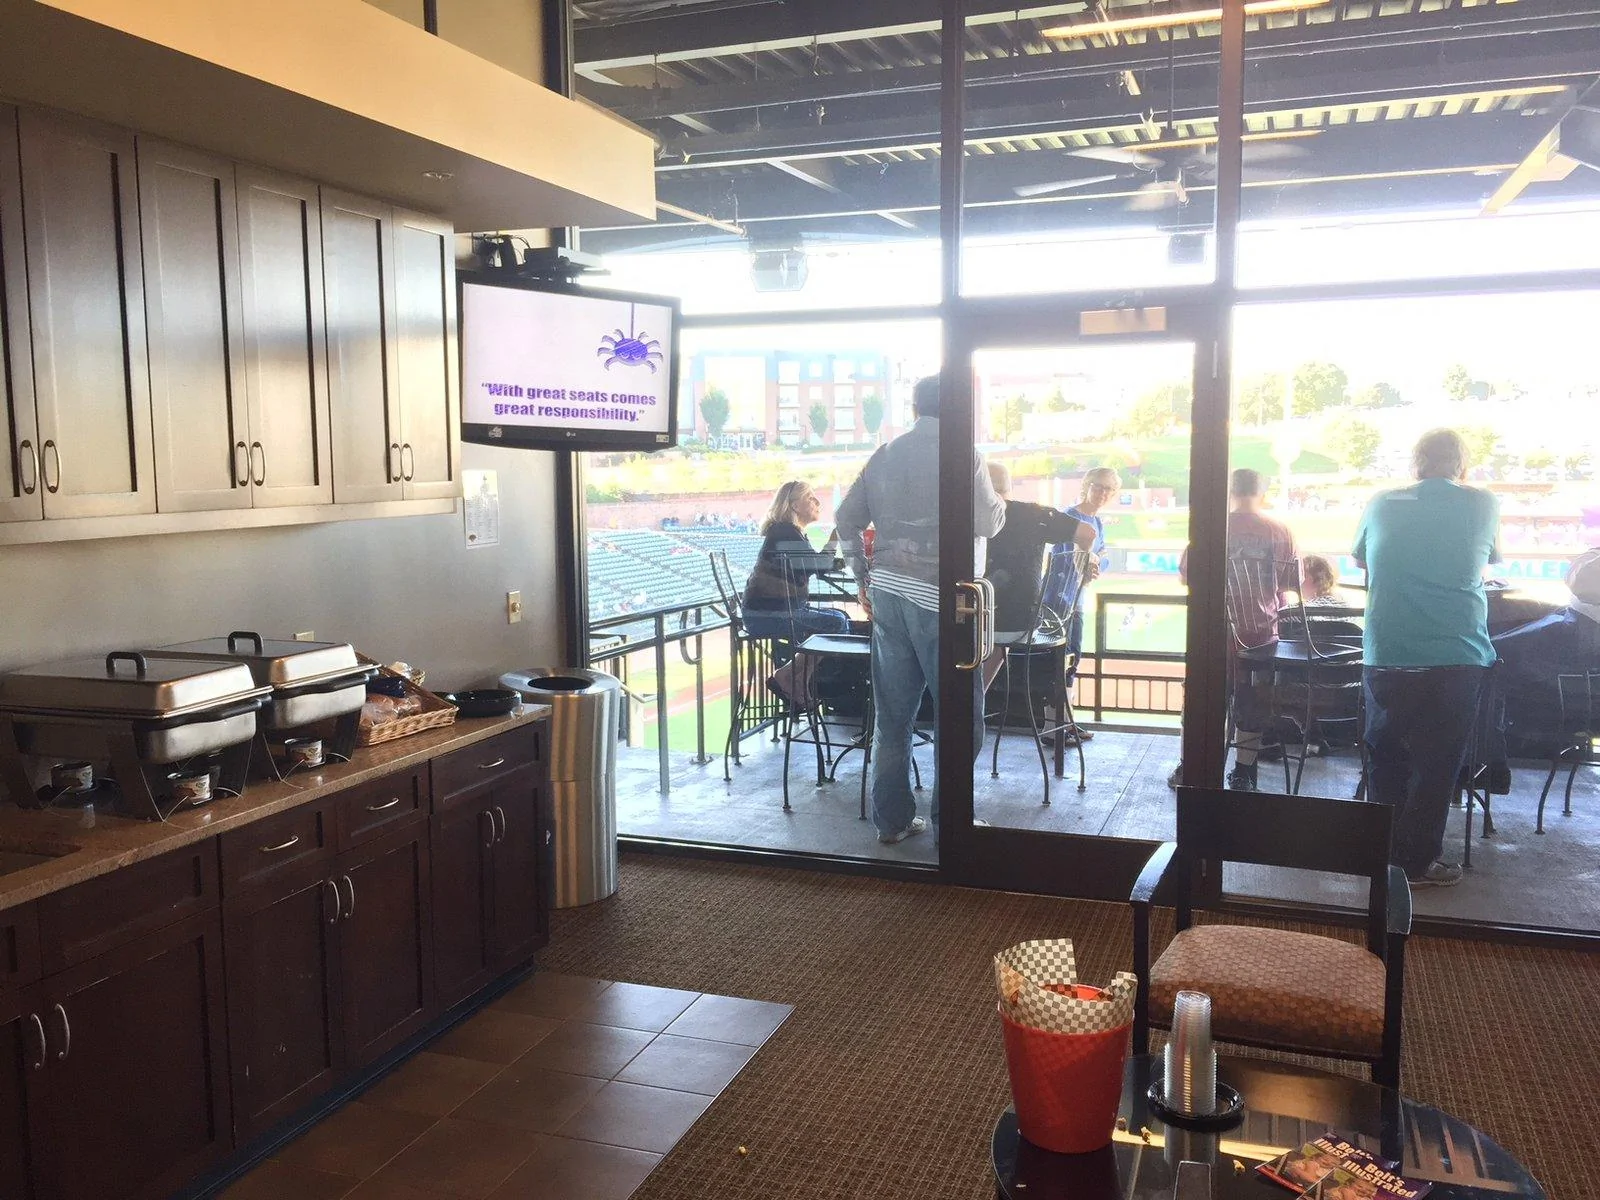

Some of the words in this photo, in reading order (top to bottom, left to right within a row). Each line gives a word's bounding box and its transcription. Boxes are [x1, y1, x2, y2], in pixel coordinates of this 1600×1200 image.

[527, 386, 567, 400] great
[569, 389, 608, 403] seats
[611, 391, 657, 406] comes
[494, 402, 535, 416] great
[1138, 552, 1180, 573] SAL
[1313, 1138, 1350, 1159] Illust
[1342, 1160, 1419, 1198] Illustrated
[1364, 1163, 1406, 1187] Bolt's
